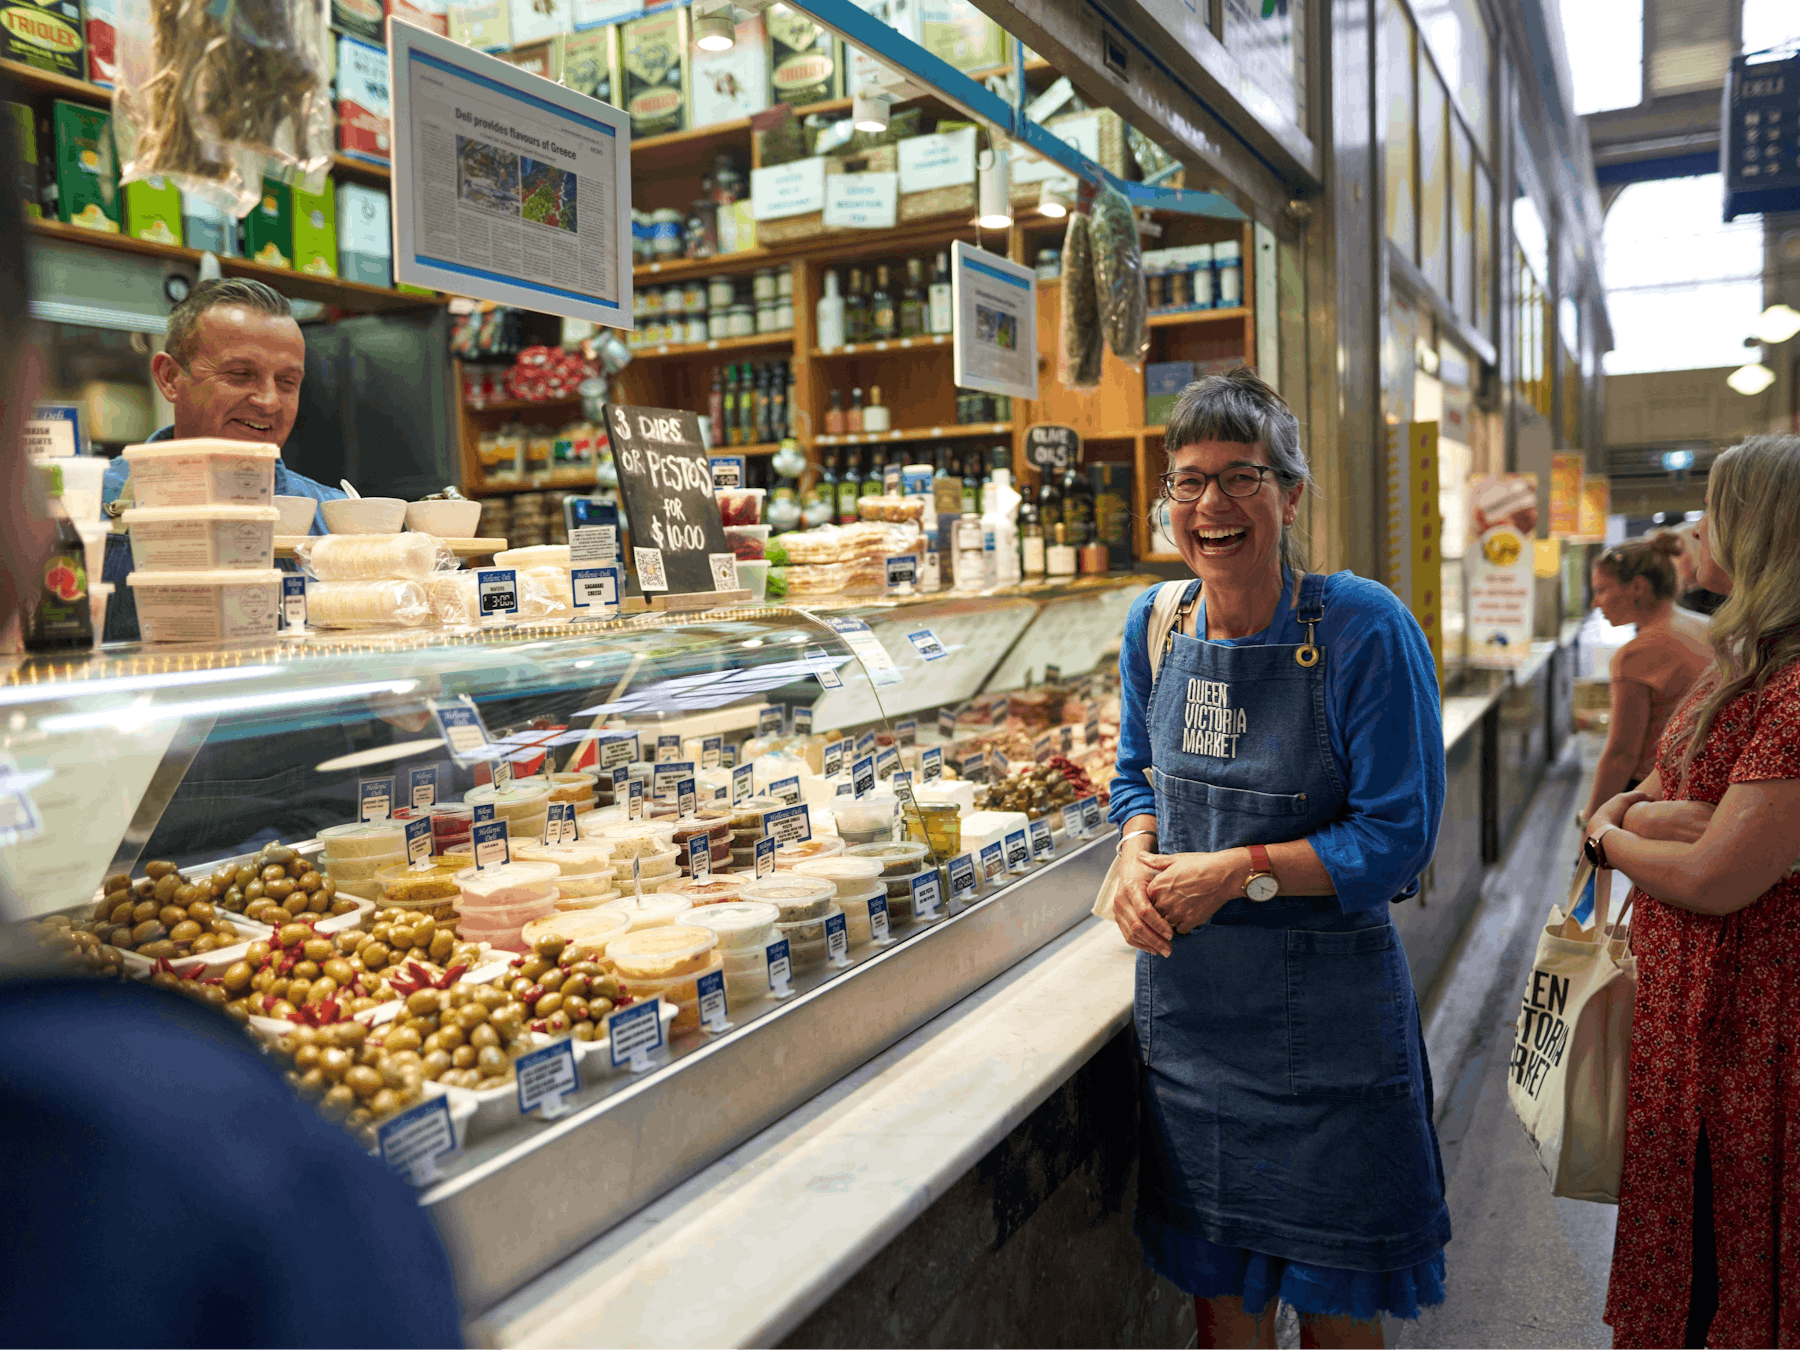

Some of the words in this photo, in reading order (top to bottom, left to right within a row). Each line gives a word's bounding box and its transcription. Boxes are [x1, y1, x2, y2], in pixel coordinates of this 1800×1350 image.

[456, 108, 472, 123] Deli
[474, 116, 508, 136] provides
[510, 125, 541, 147] flavours
[542, 139, 550, 150] of
[551, 142, 577, 160] Greece
[615, 409, 632, 440] 3
[638, 415, 682, 443] DIPS
[622, 449, 646, 474] OR
[646, 450, 713, 498] PESTOS
[663, 497, 686, 522] FOR
[482, 574, 500, 582] Hellenic
[501, 572, 511, 580] Deli
[577, 570, 599, 579] Hellenic
[1187, 678, 1229, 708] QUEEN
[1185, 702, 1247, 734] VICTORIA
[1182, 728, 1240, 758] MARKET
[366, 782, 387, 791] Hellenic
[410, 821, 426, 833] Hellenic
[771, 810, 789, 820] Hellenic
[791, 807, 802, 816] Deli
[478, 826, 501, 836] Hellenic
[485, 834, 497, 842] Deli
[1523, 969, 1570, 1016] EN
[1516, 1005, 1570, 1068] TORIA
